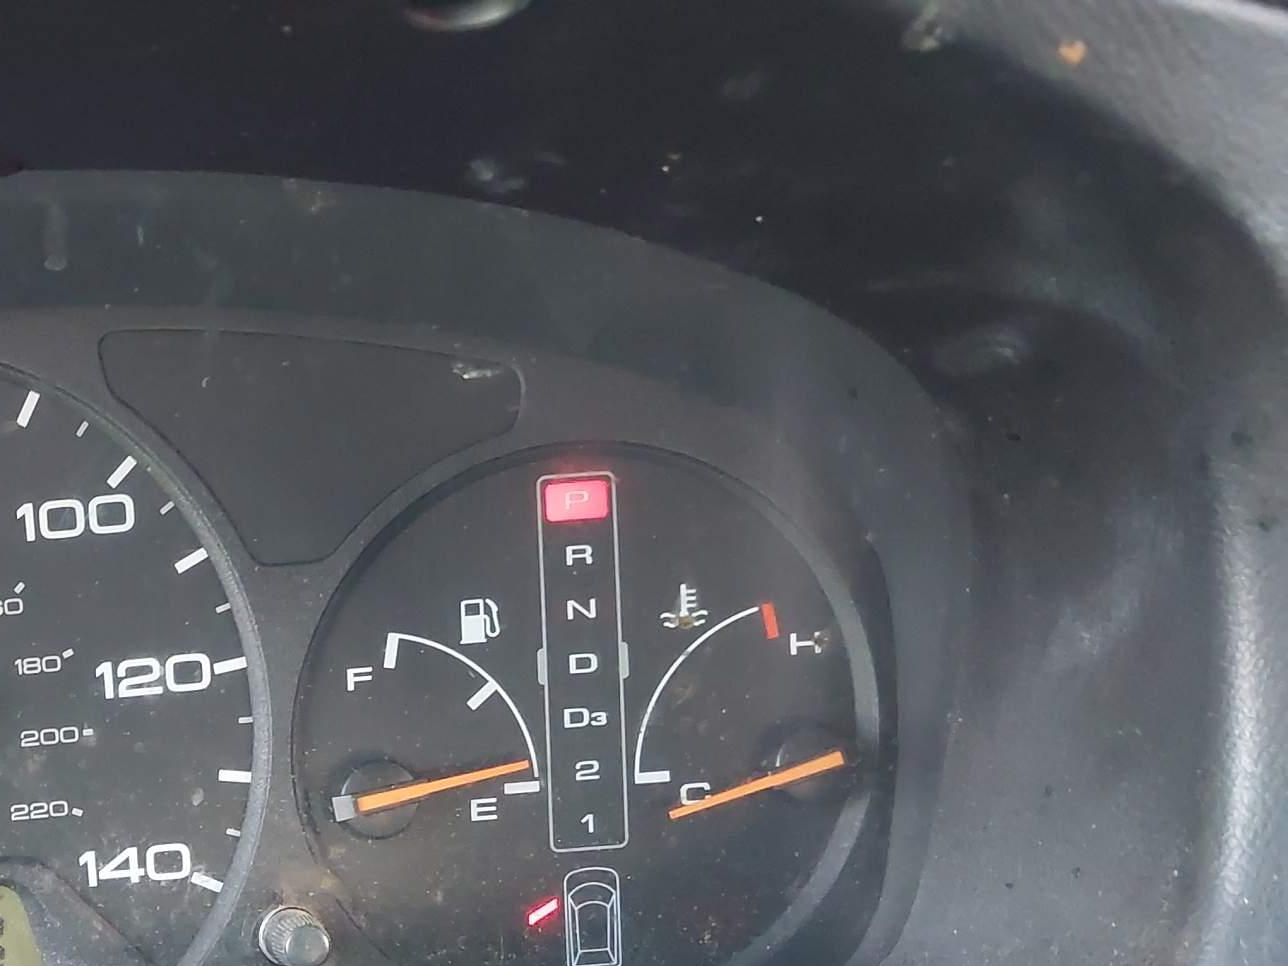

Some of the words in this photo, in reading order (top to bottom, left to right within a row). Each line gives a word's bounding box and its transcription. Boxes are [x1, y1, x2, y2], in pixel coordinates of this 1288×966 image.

[564, 490, 590, 512] P
[16, 493, 135, 542] 100
[565, 544, 593, 566] R
[566, 598, 597, 621] N
[790, 631, 822, 655] H
[14, 654, 61, 675] 180
[569, 653, 598, 675] D
[95, 652, 211, 700] 120
[346, 666, 373, 692] F
[563, 707, 608, 729] D3
[20, 726, 79, 747] 200
[575, 760, 601, 781] 2
[680, 782, 711, 806] C
[11, 800, 68, 821] 220
[471, 798, 498, 822] E
[580, 813, 594, 834] 1
[78, 843, 191, 888] 140
